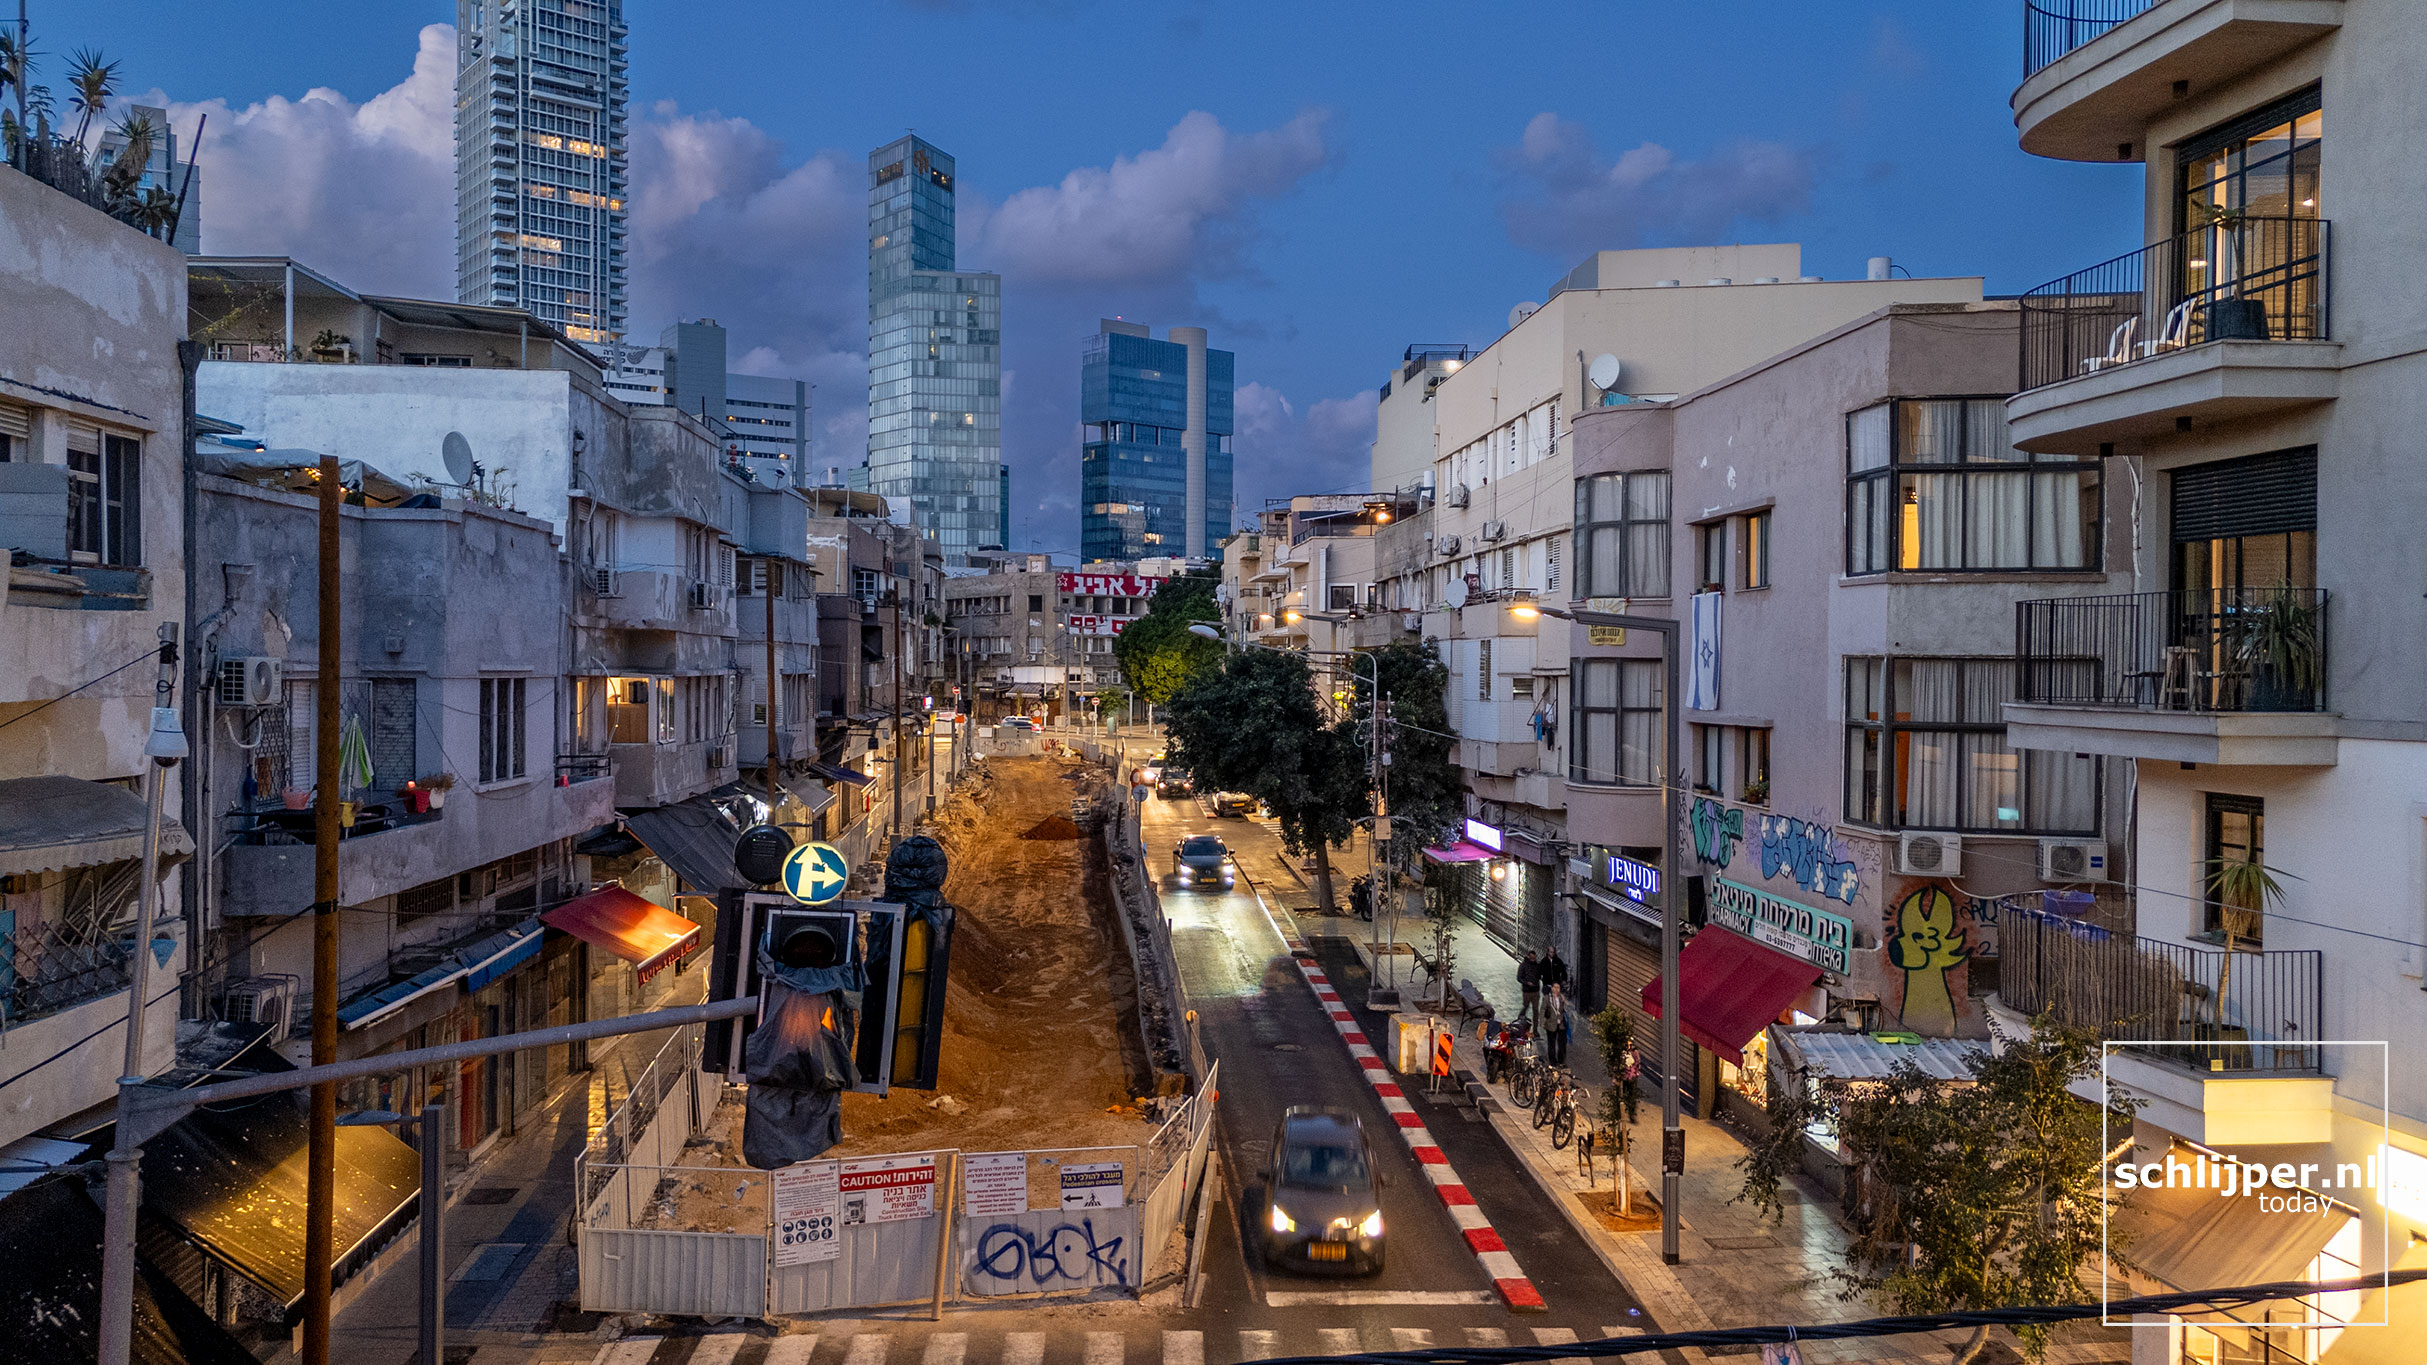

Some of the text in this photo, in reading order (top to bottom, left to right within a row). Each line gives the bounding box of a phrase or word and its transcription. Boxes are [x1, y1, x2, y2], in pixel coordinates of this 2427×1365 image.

[1074, 575, 1126, 596] אביב
[1609, 856, 1657, 892] JENUDI
[1711, 904, 1751, 933] PHARMACY
[1760, 896, 1811, 935] מרקחת
[1816, 917, 1845, 947] בית
[841, 1174, 891, 1187] CAUTION
[893, 1169, 933, 1183] זהירות!
[883, 1185, 927, 1197] אתר בניה
[906, 1193, 927, 1201] כניסה
[881, 1207, 917, 1215] Construction
